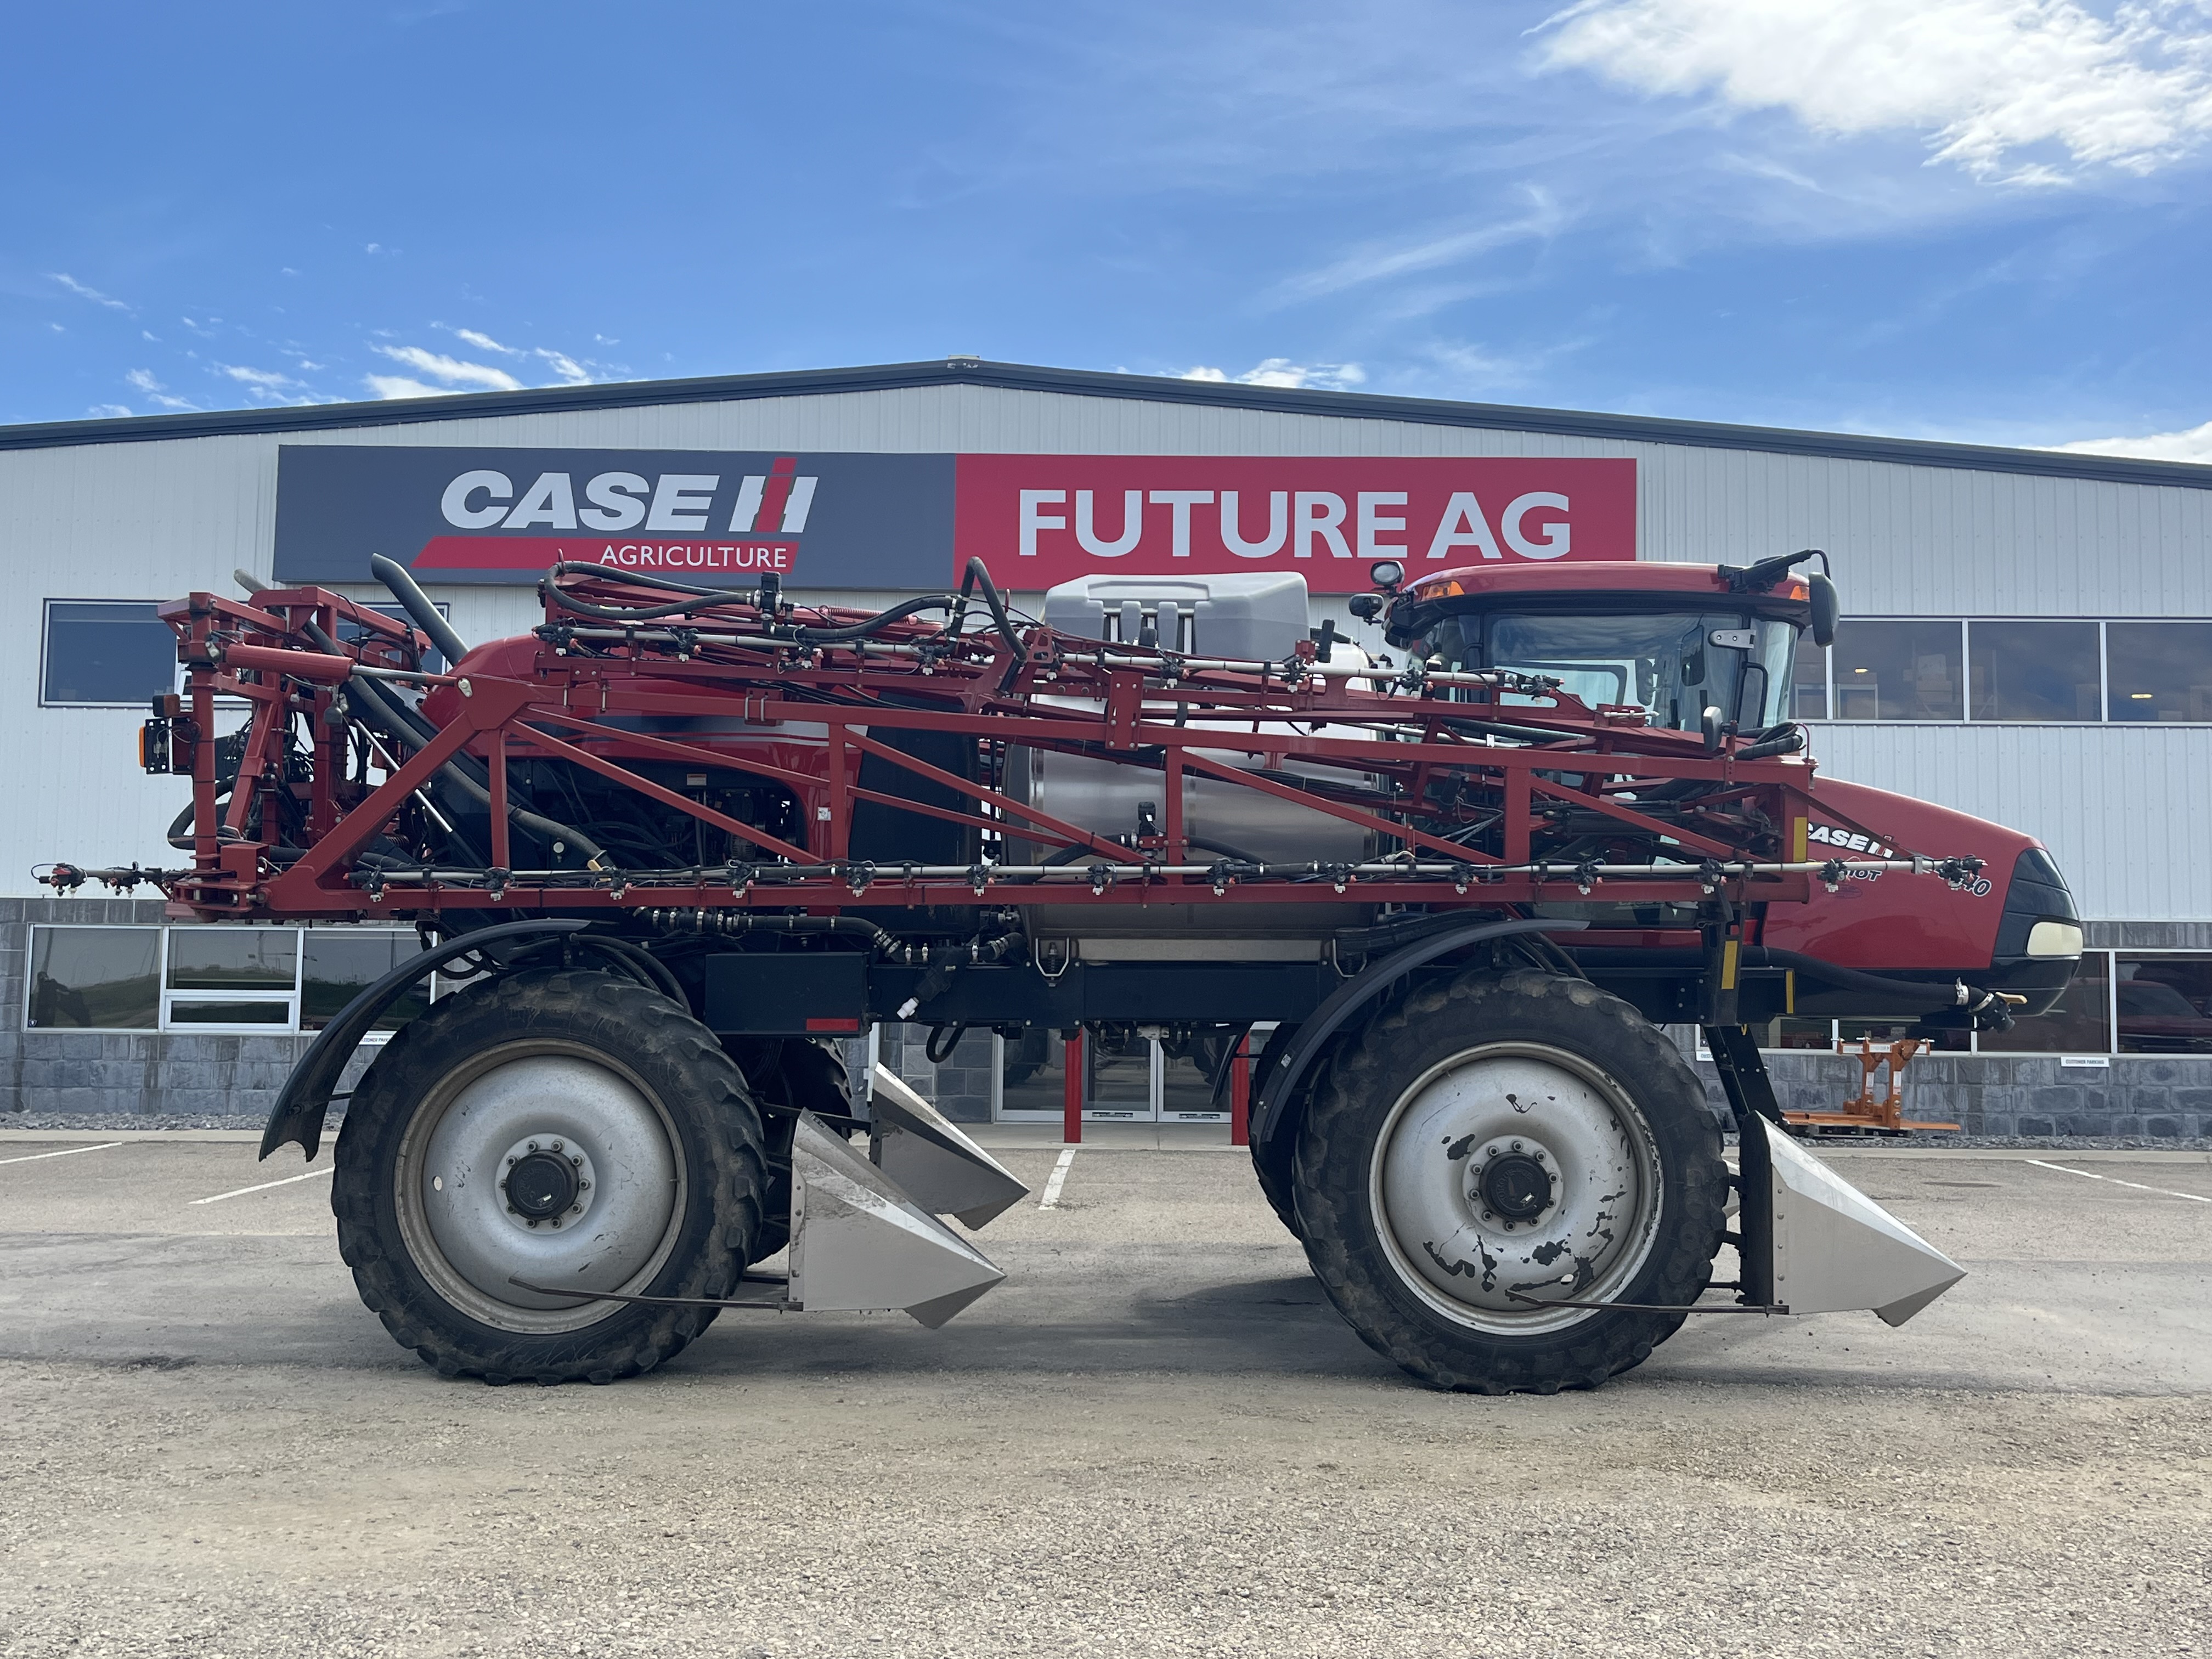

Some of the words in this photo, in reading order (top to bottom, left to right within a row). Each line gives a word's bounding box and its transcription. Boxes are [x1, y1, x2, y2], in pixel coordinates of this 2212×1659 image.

[441, 470, 720, 531] CASE
[1019, 489, 1408, 558] FUTURE
[1426, 492, 1570, 560] AG
[600, 545, 786, 567] AGRICULTURE
[1808, 823, 1869, 851] ASE
